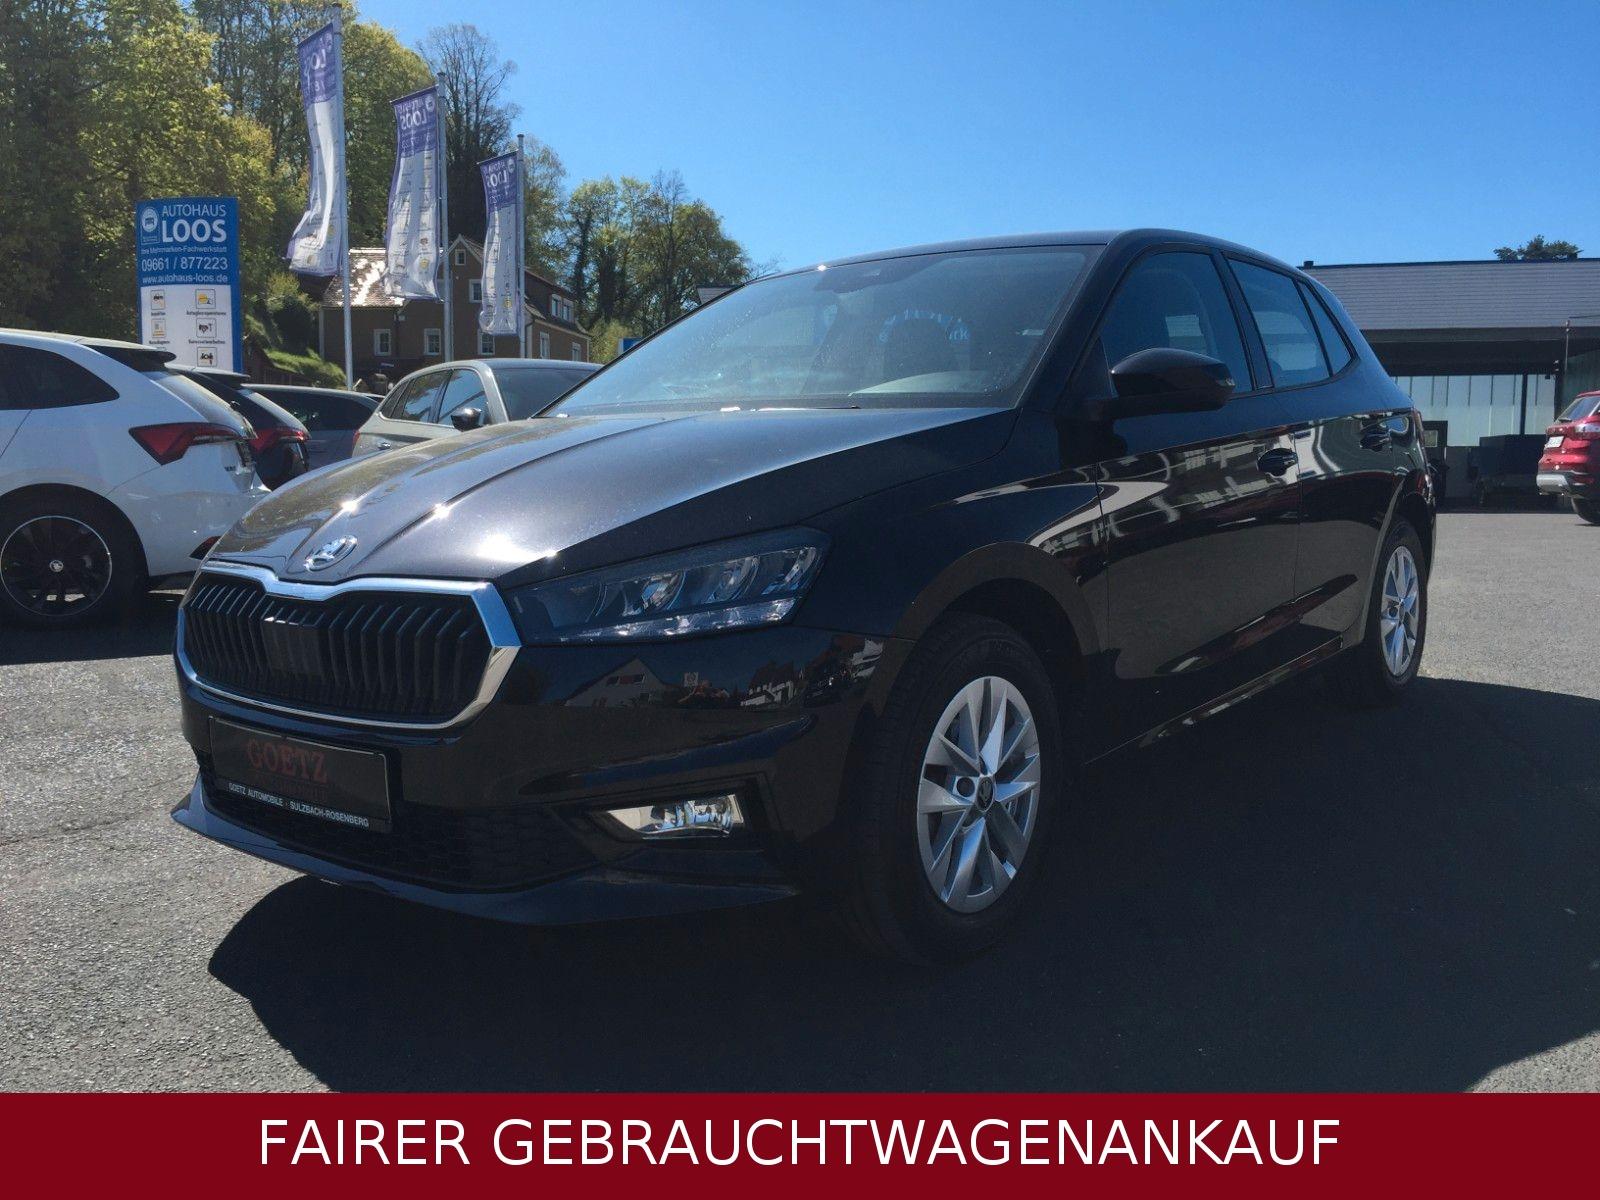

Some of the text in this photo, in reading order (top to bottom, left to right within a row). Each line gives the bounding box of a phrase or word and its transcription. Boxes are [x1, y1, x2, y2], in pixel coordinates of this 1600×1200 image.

[162, 204, 227, 217] AUTOHAUS
[162, 219, 227, 243] LOOS
[141, 258, 169, 272] 09661
[180, 256, 228, 270] 877223
[142, 274, 228, 284] www.autohaus-loos.de
[247, 738, 328, 784] GOETZ
[228, 782, 246, 795] GOETZ
[247, 789, 284, 807] AUTOMOBILE
[289, 800, 369, 828] SULZBACH-ROSENBERG
